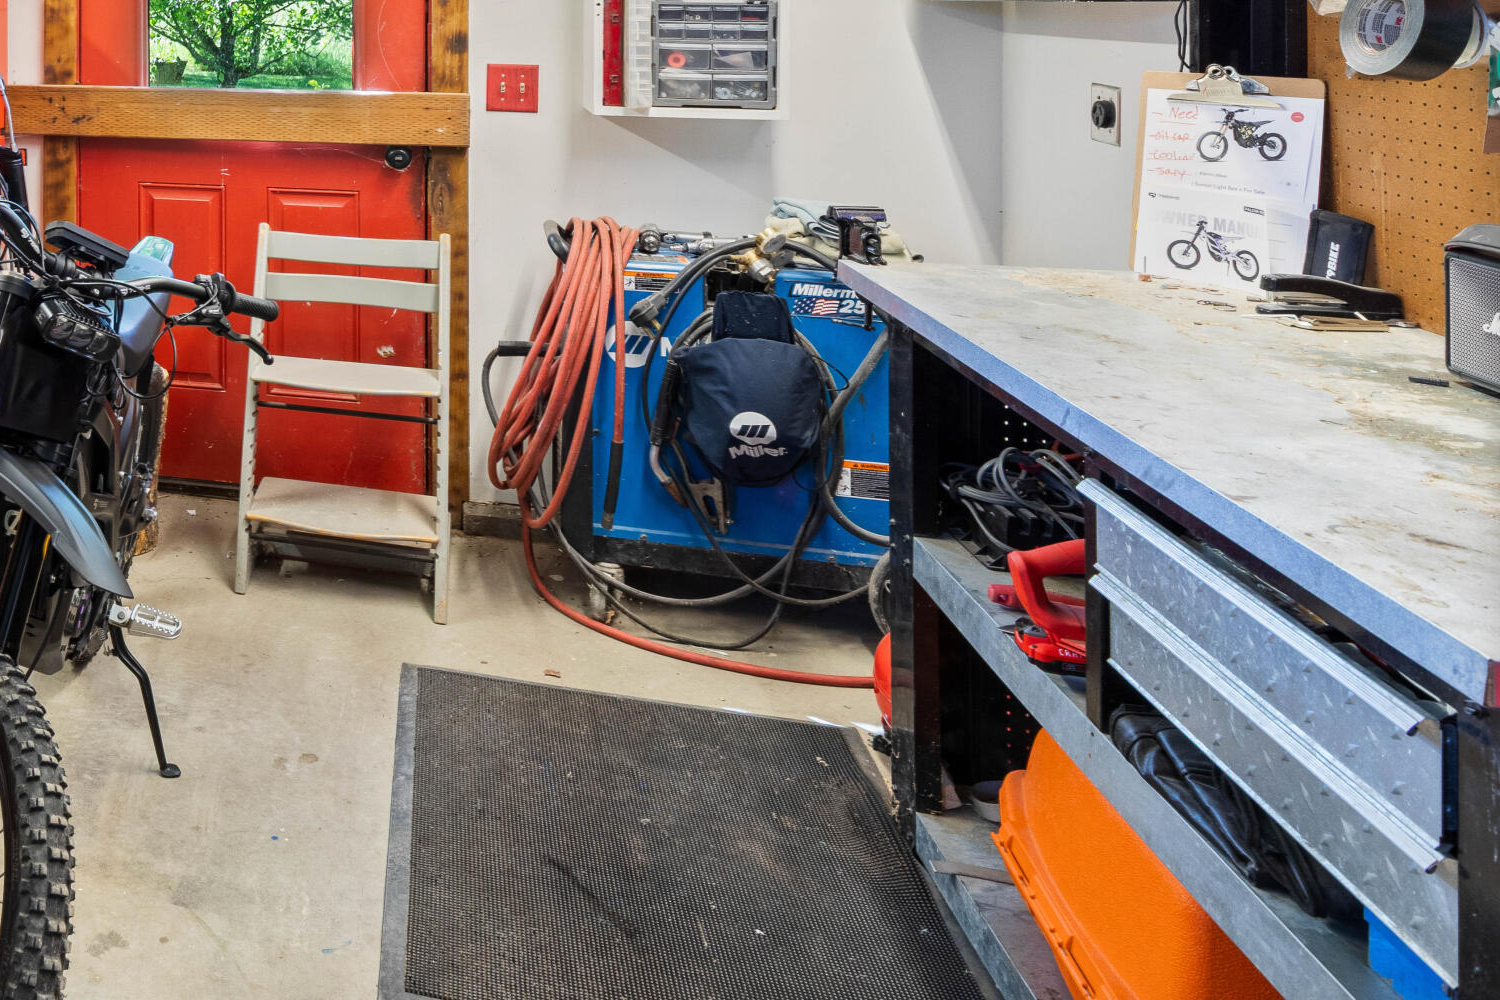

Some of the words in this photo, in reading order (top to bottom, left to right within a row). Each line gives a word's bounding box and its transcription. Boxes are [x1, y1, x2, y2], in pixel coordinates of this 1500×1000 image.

[1170, 104, 1199, 121] Need
[840, 299, 877, 317] 25
[728, 444, 788, 459] Miller
